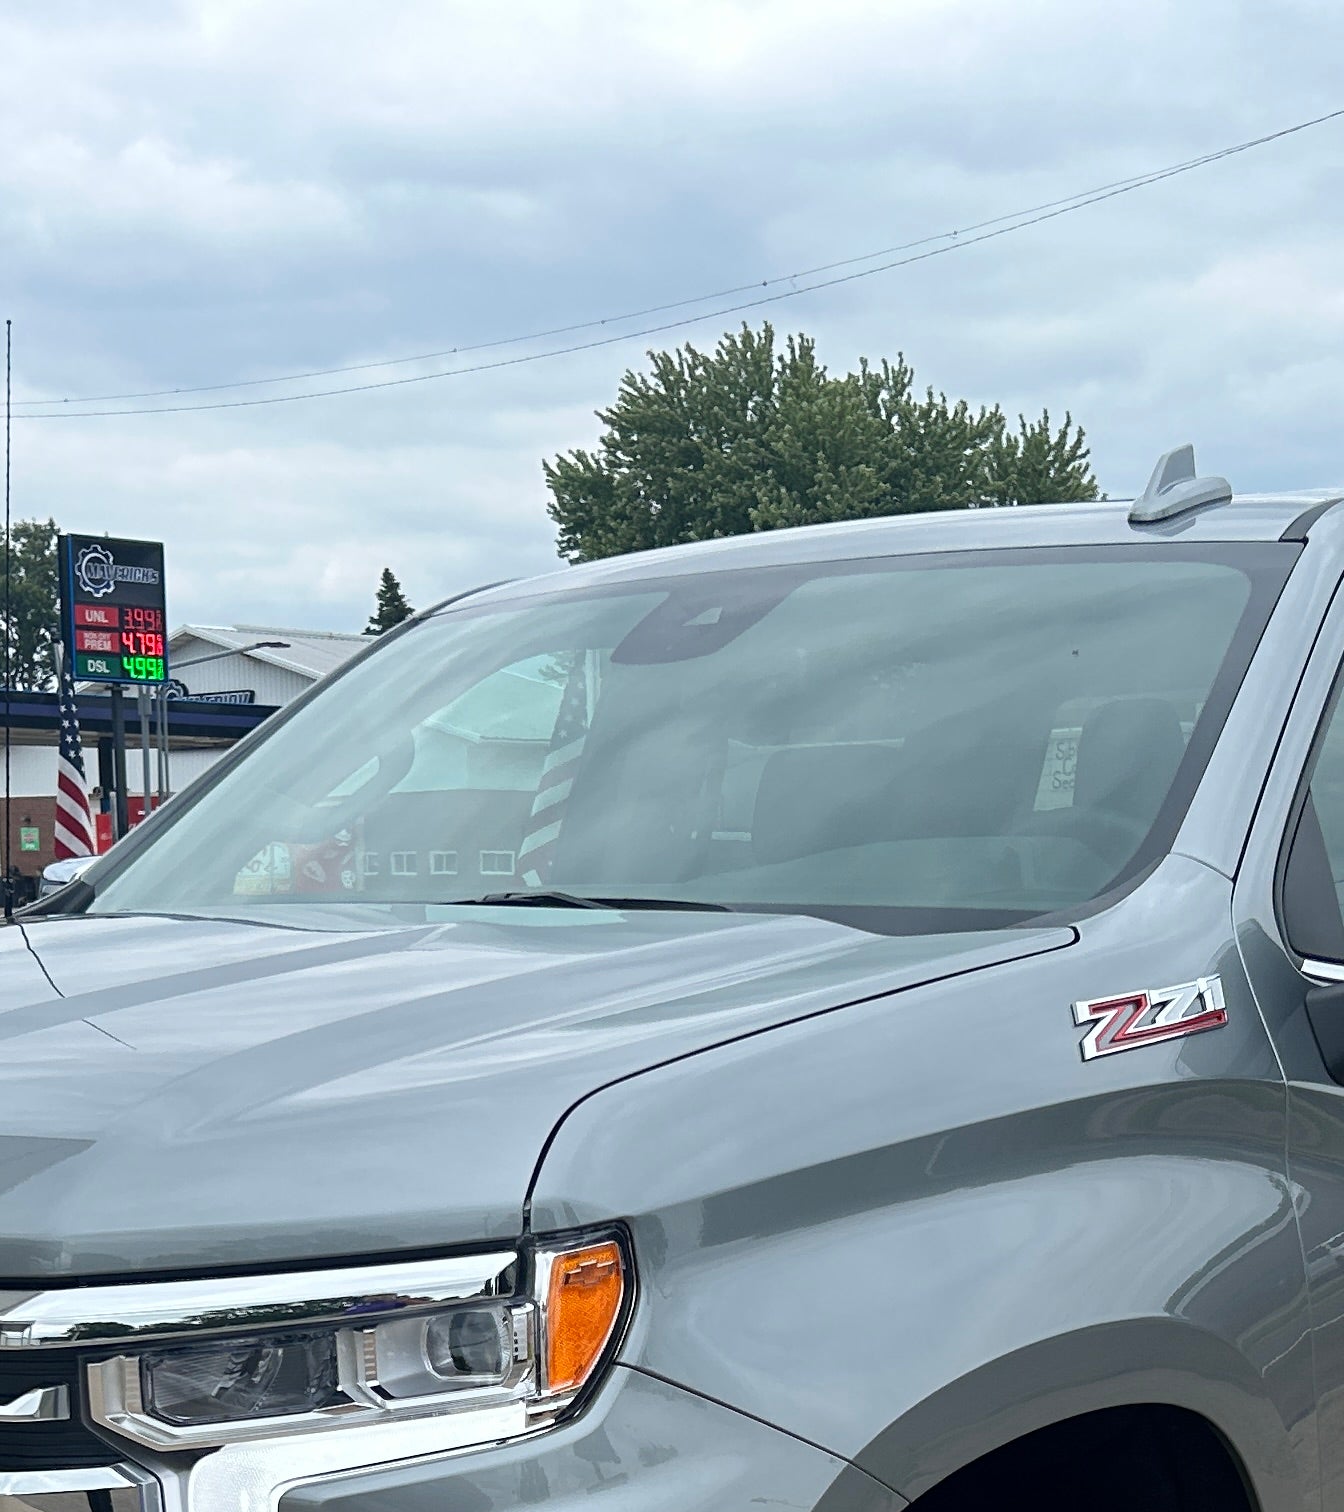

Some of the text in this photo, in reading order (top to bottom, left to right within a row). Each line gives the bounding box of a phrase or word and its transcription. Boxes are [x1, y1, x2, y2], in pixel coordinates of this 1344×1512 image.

[85, 609, 109, 623] UNL
[87, 659, 110, 674] DSL
[1072, 974, 1228, 1062] Z71
